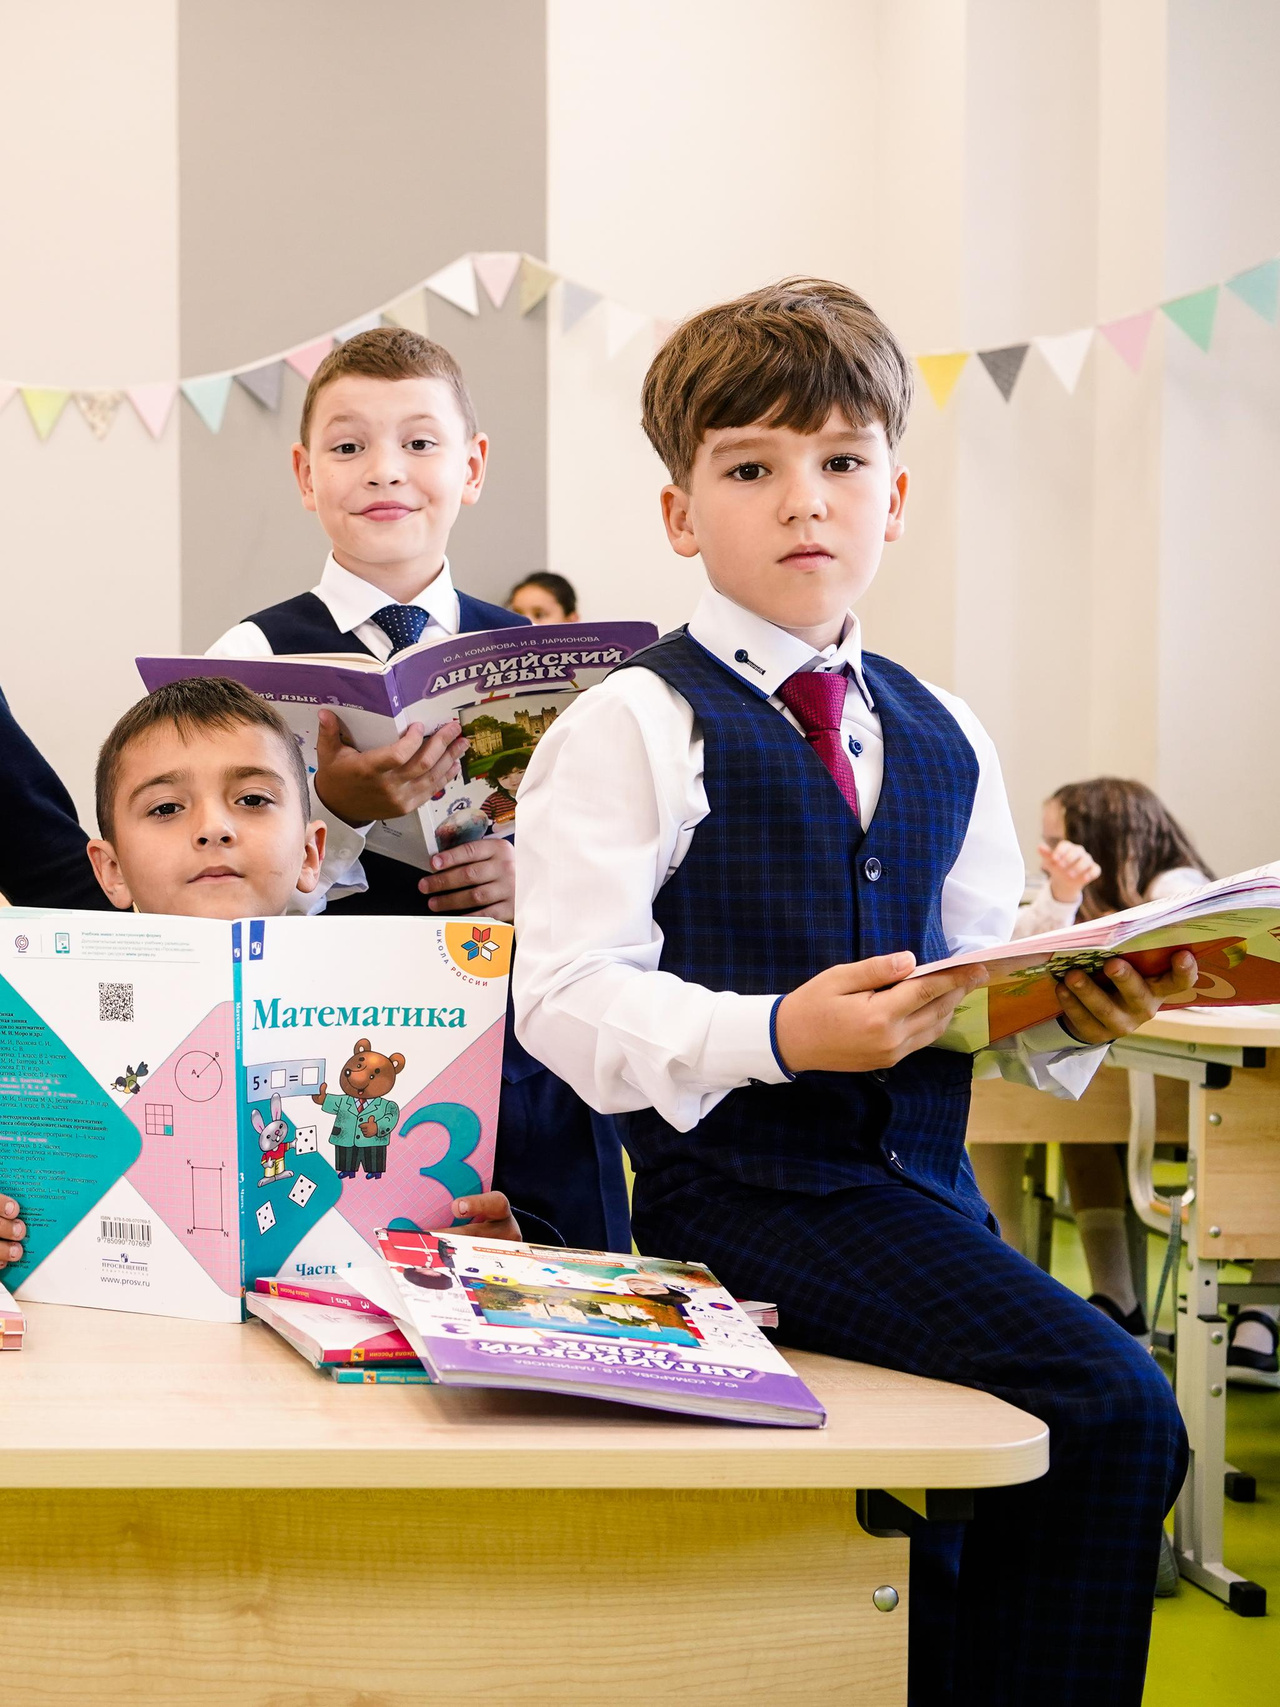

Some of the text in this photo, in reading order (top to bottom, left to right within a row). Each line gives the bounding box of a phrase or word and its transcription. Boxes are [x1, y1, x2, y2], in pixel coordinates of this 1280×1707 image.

[442, 653, 463, 664] Ю.А.
[464, 643, 519, 657] КОМАРОВА,
[541, 636, 600, 645] ЛАРИОНОВА
[430, 648, 623, 693] АНГЛИЙСКИЙ
[484, 665, 568, 689] ЯЗЫК
[281, 694, 320, 704] ЯЗЫК
[326, 696, 341, 707] 3
[436, 929, 488, 987] ШКОЛА РОССИИ
[235, 1001, 243, 1050] Математика
[252, 998, 467, 1030] Математика
[253, 1075, 260, 1092] 5
[399, 1102, 482, 1233] 3
[100, 1276, 150, 1287] www.prosv.ru
[369, 1350, 393, 1358] России
[477, 1341, 751, 1379] АНГЛИЙСКИЙ
[551, 1339, 669, 1361] ЯЗЫК
[513, 1358, 595, 1372] ЛАРИОНОВА
[628, 1370, 707, 1385] КОМАРОВА,
